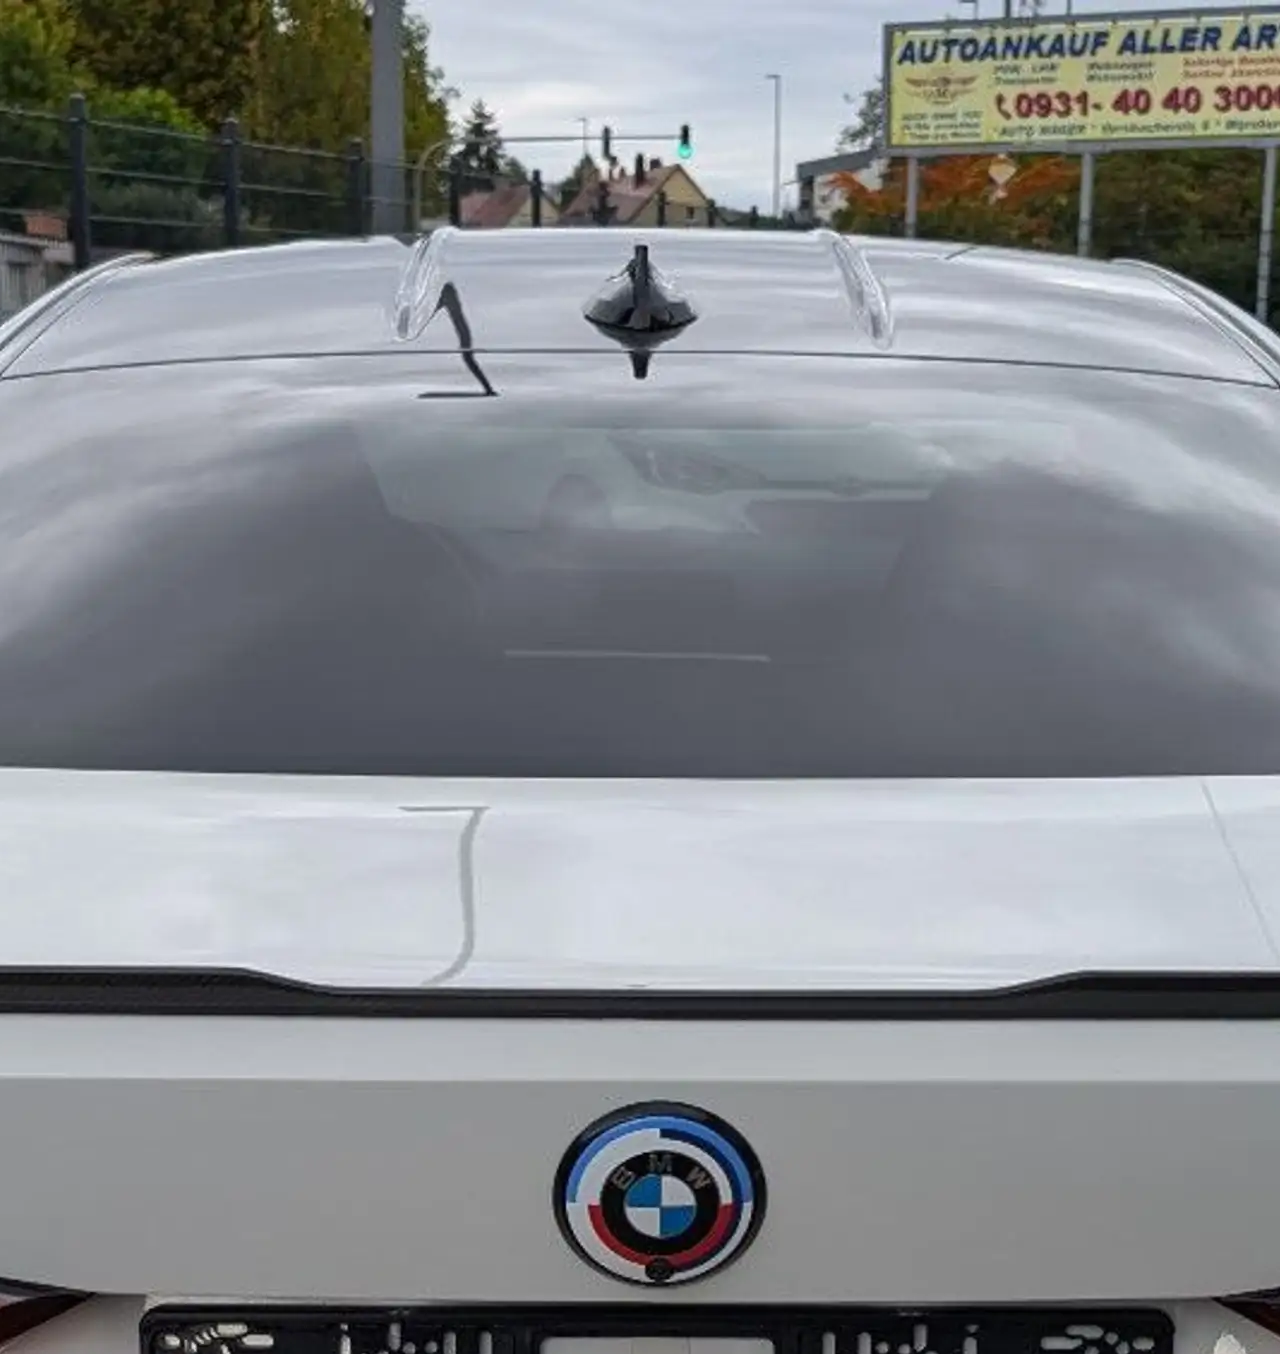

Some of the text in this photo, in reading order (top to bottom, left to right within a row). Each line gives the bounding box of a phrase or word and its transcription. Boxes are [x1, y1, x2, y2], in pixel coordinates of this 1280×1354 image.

[897, 30, 1109, 65] AUTOANKAUF
[1117, 26, 1222, 55] ALLER
[1111, 87, 1152, 115] 40
[1162, 86, 1202, 114] 40
[611, 1153, 712, 1191] BMW
